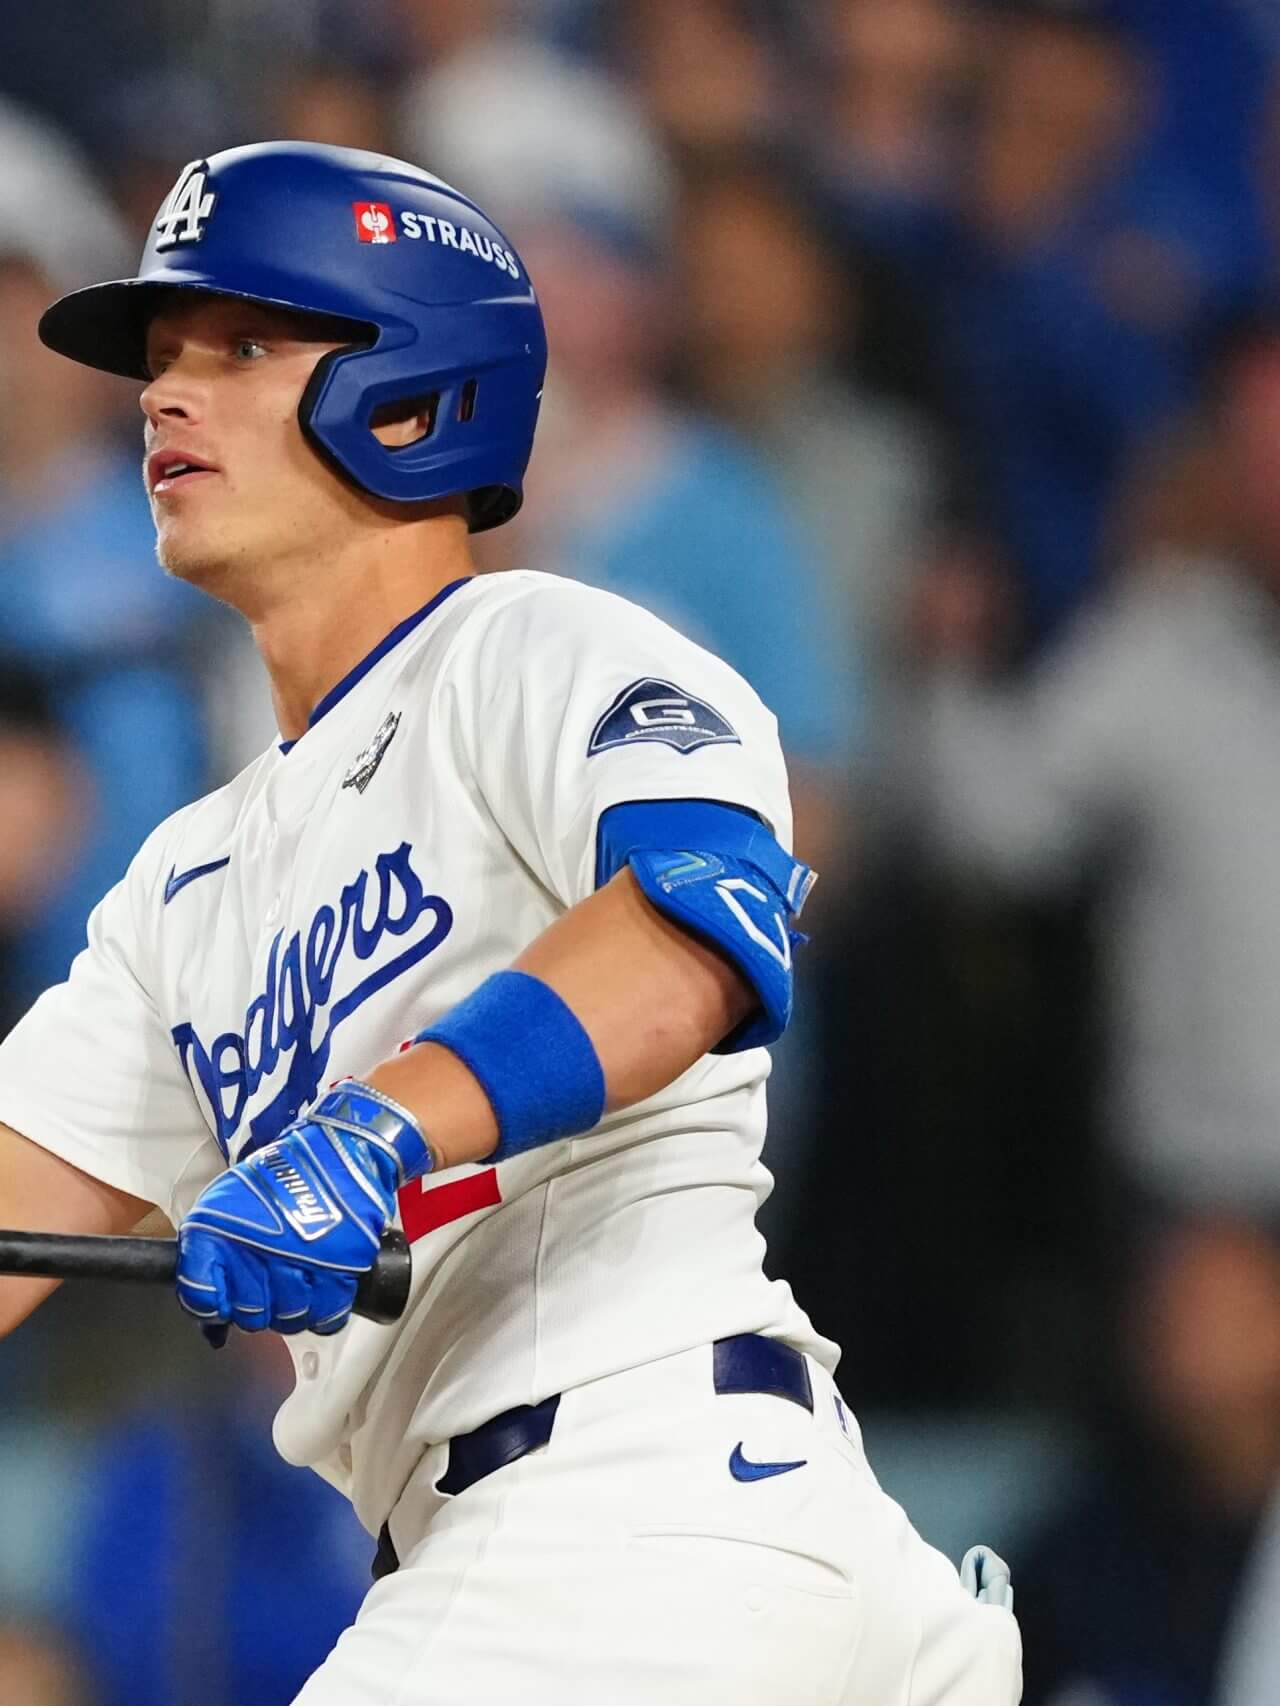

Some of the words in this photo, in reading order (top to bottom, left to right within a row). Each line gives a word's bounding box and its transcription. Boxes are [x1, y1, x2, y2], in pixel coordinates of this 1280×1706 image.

[156, 160, 215, 253] LA
[401, 211, 521, 280] STRAUSS
[629, 698, 697, 727] G
[171, 841, 454, 1167] Dodgers
